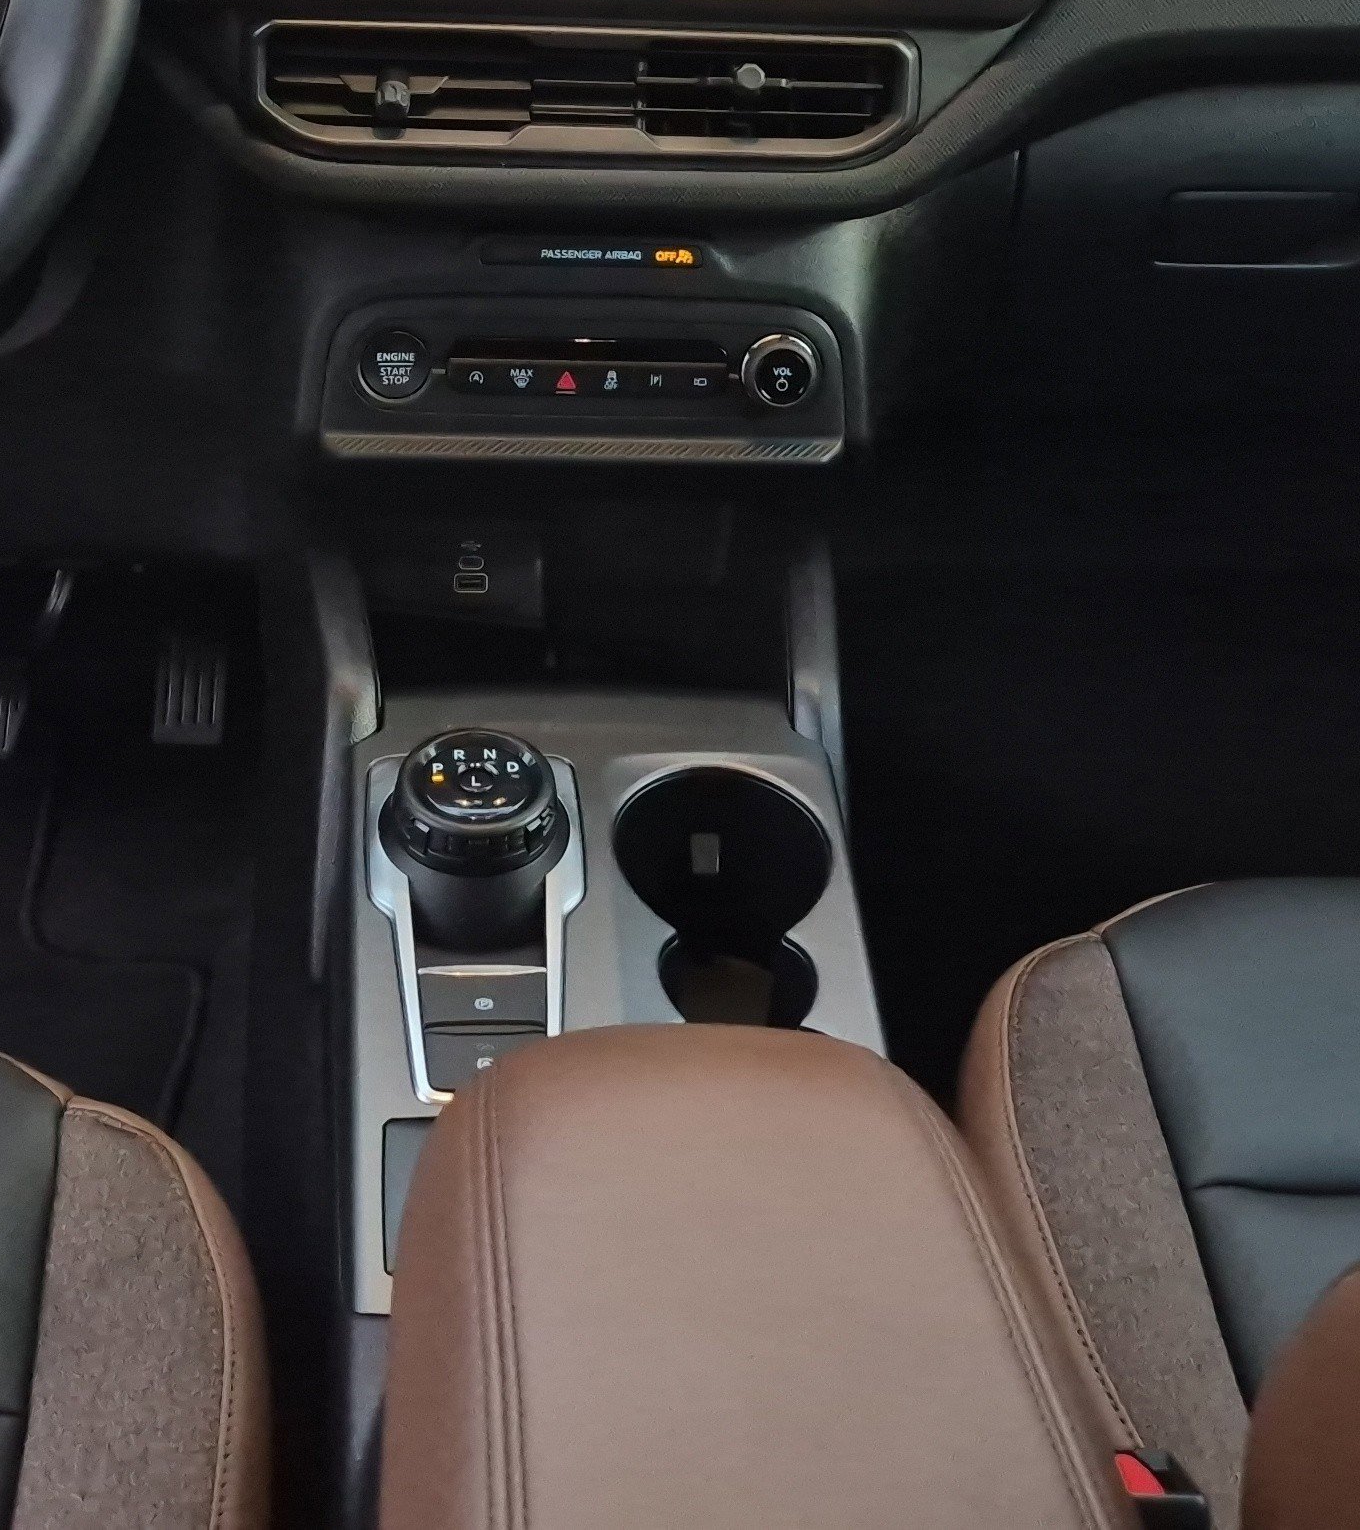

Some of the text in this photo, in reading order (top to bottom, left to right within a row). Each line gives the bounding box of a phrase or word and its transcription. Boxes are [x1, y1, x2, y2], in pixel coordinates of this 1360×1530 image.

[540, 249, 676, 262] PASSENGER AIRBAG OFF
[376, 352, 416, 362] ENGINE
[380, 367, 412, 377] START
[510, 368, 533, 378] MAX
[772, 367, 793, 376] VOL
[382, 376, 410, 385] STOP
[453, 749, 465, 760] R
[483, 749, 497, 760] N
[432, 762, 444, 774] P
[506, 761, 520, 773] D
[471, 775, 482, 787] L
